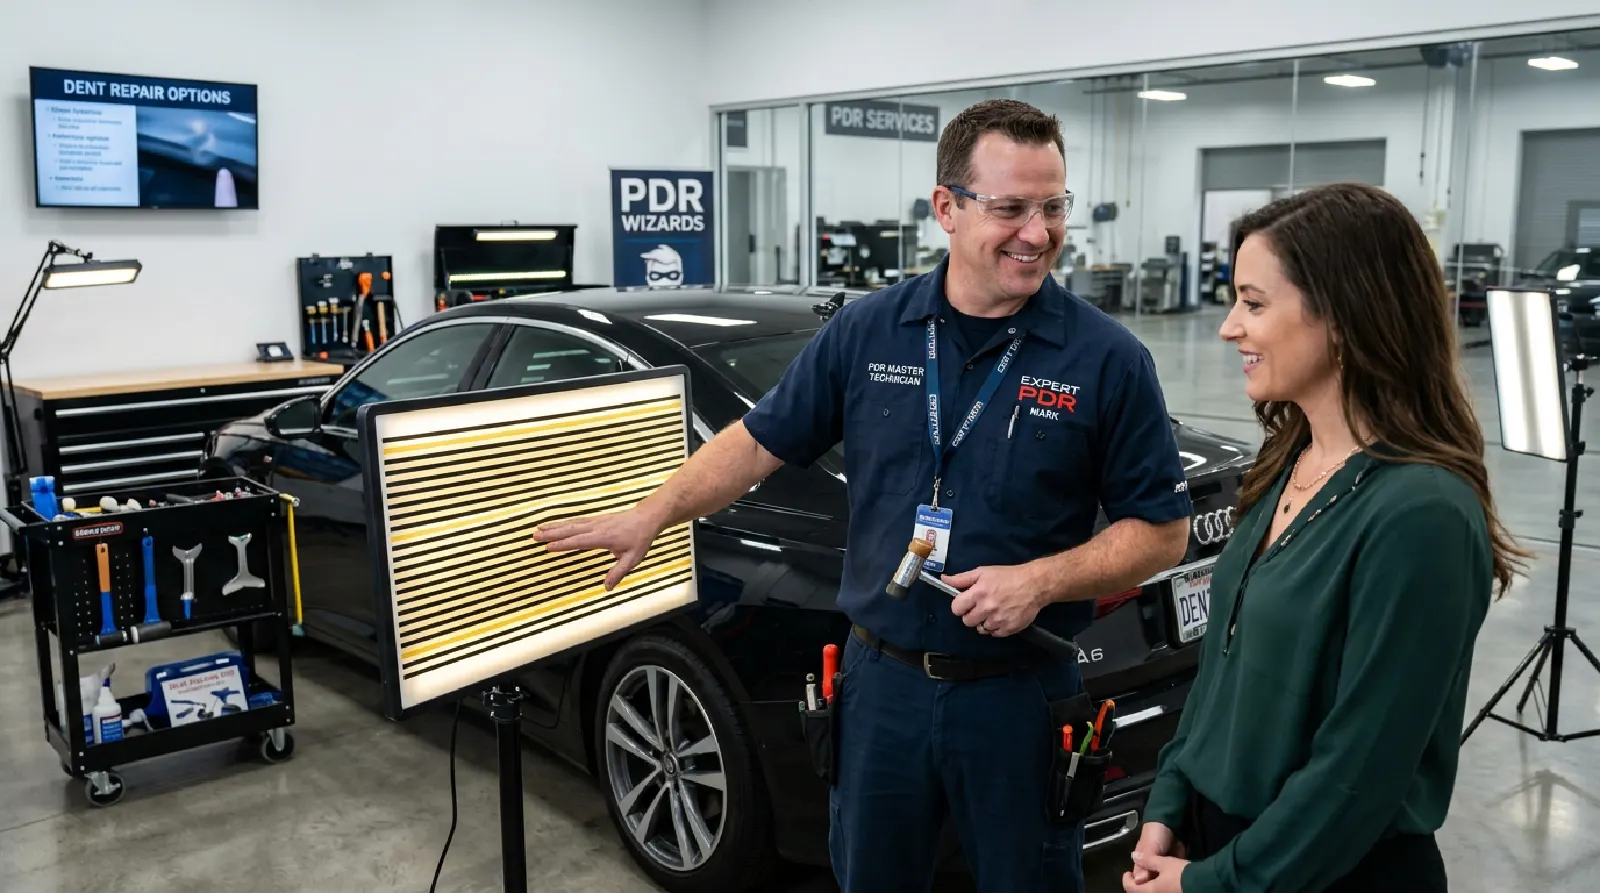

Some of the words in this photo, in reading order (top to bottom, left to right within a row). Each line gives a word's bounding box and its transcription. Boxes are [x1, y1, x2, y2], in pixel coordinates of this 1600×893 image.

[64, 79, 107, 96] DENT
[110, 83, 165, 100] REPAIR
[167, 87, 231, 105] OPTIONS
[830, 106, 864, 128] PDR
[866, 108, 935, 135] SERVICES
[620, 178, 704, 213] PDR
[621, 214, 705, 232] WIZARDS
[868, 362, 886, 373] PDR
[887, 364, 925, 377] MASTER
[1020, 375, 1080, 395] EXPERT
[1018, 385, 1077, 413] PDR
[1029, 407, 1060, 421] MARK
[1179, 587, 1211, 627] DEN
[1077, 647, 1104, 664] A6
